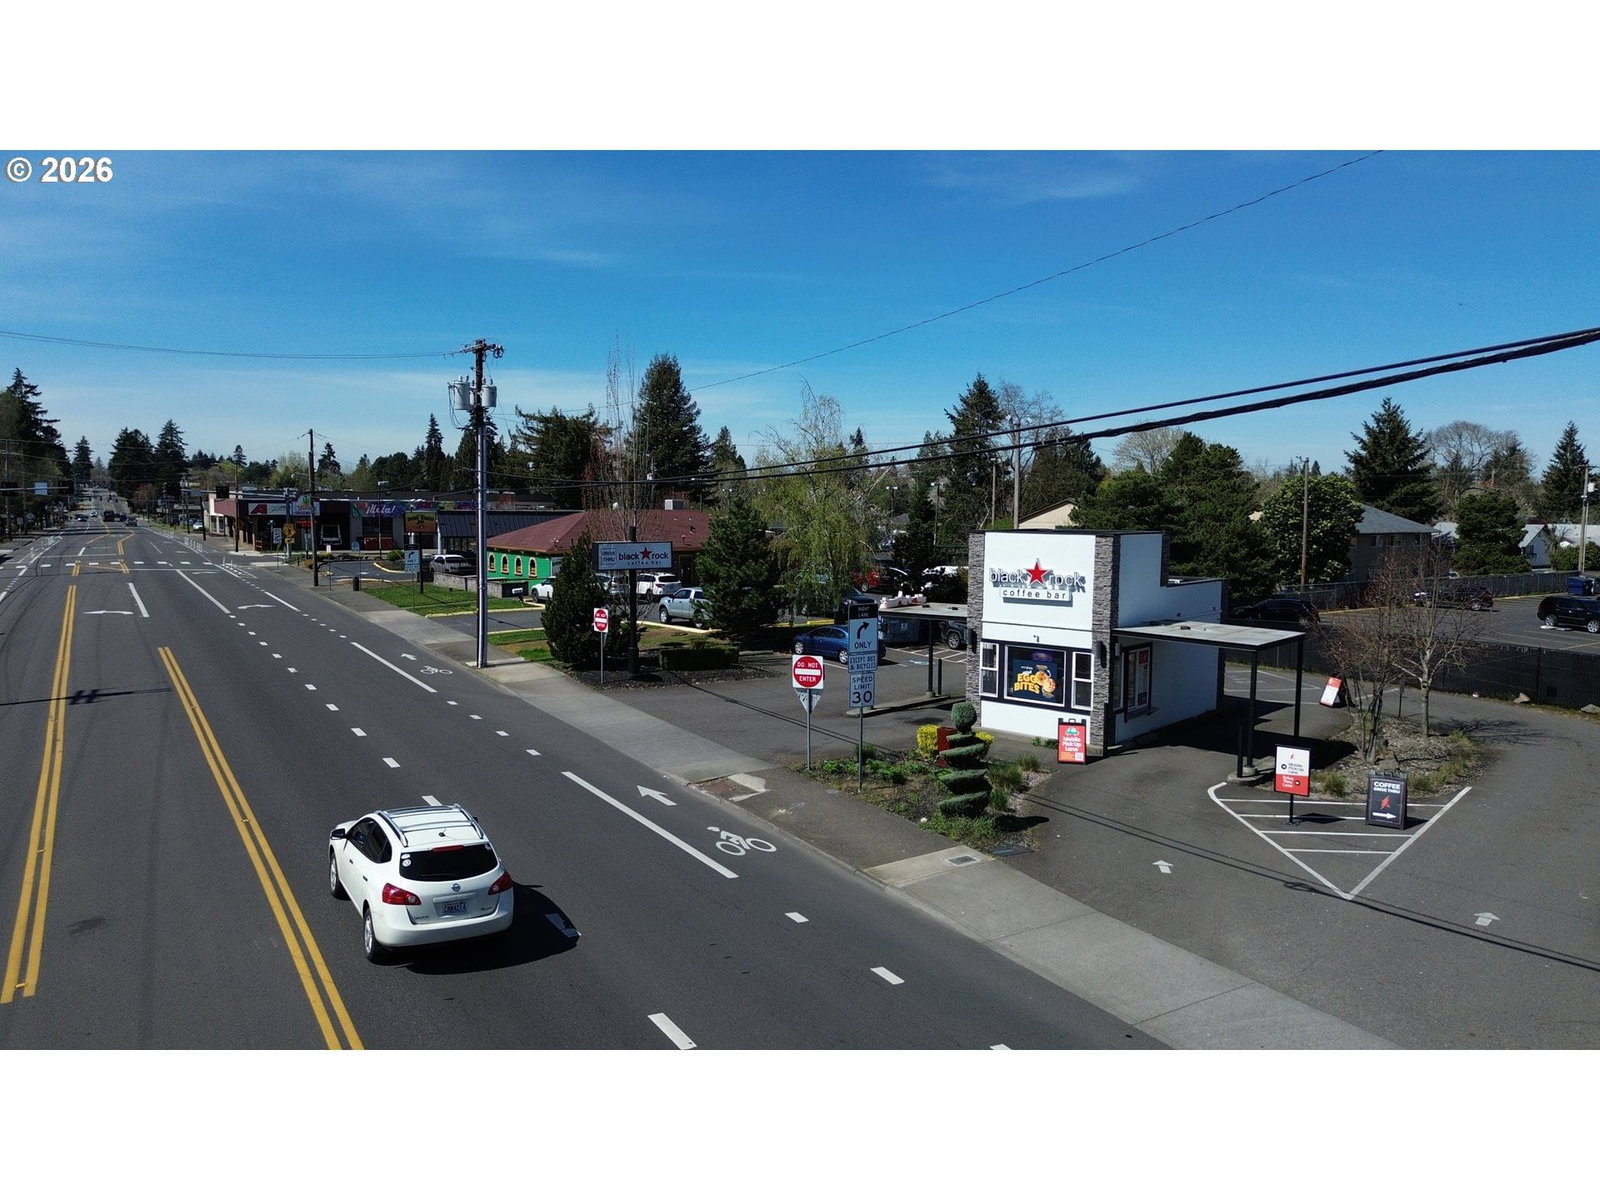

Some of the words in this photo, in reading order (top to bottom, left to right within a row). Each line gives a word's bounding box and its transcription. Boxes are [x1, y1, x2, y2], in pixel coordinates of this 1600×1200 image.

[618, 553, 640, 561] black
[652, 552, 669, 560] rock
[989, 568, 1027, 584] black
[1049, 572, 1085, 587] rock
[1003, 589, 1040, 598] coffee
[1046, 591, 1066, 599] bar
[854, 641, 872, 649] ONLY
[1017, 673, 1038, 684] EGG
[1014, 682, 1040, 694] BITES
[852, 690, 872, 704] 30
[1373, 781, 1401, 790] COFFEE
